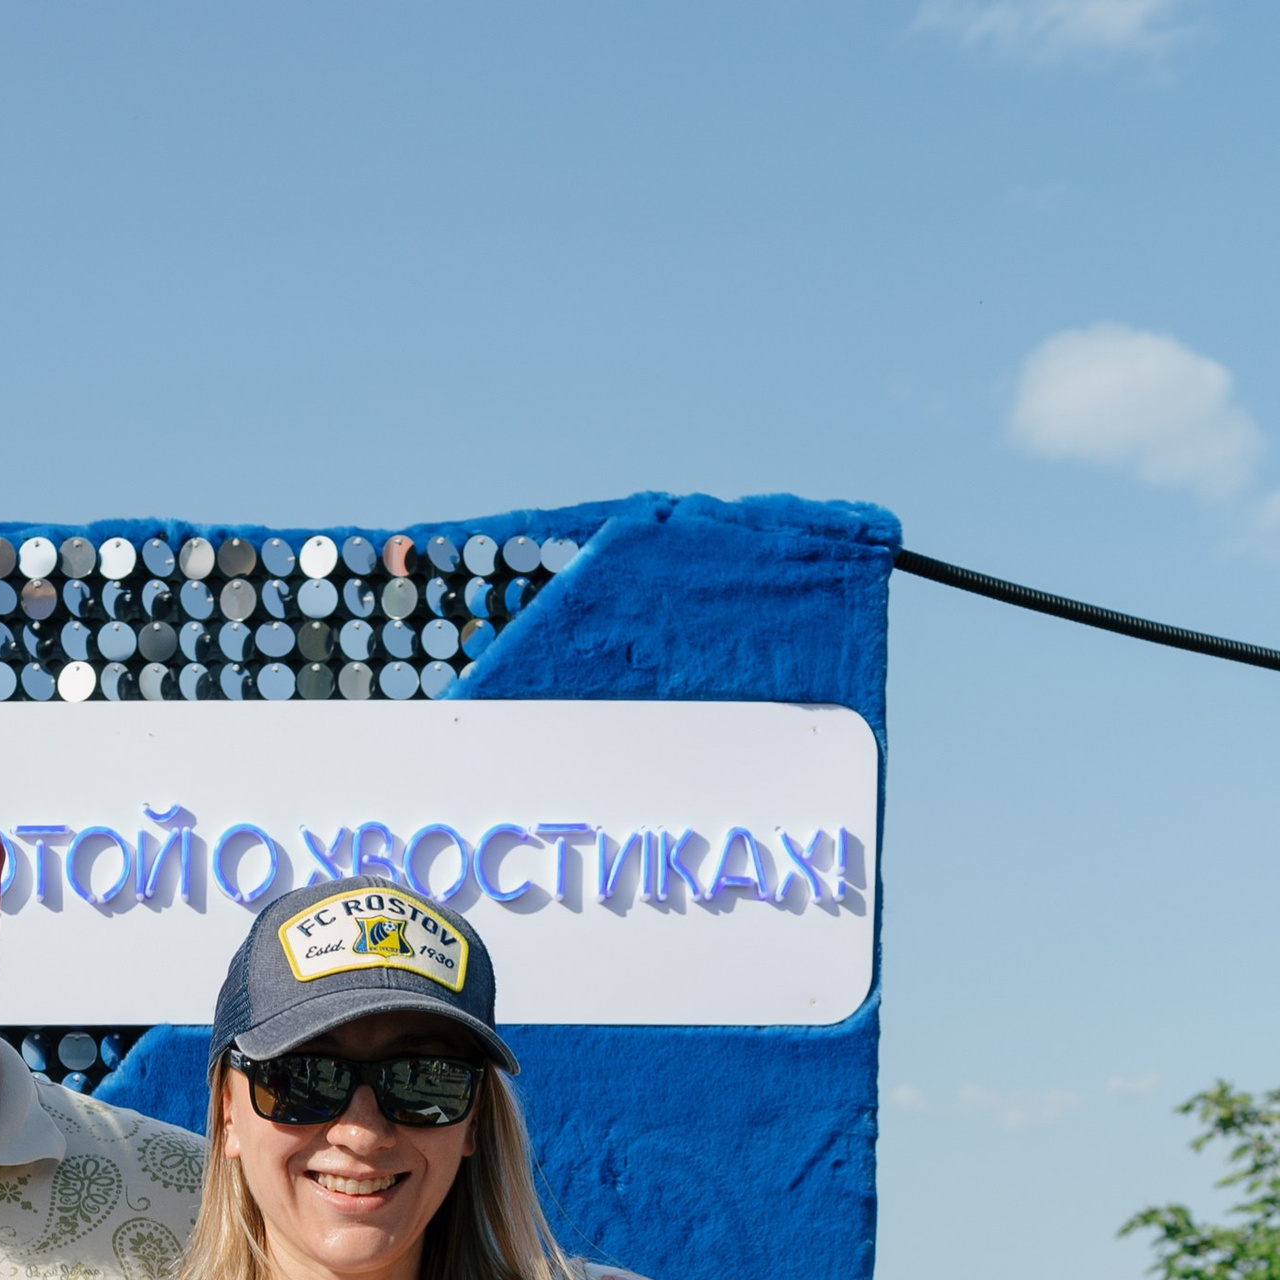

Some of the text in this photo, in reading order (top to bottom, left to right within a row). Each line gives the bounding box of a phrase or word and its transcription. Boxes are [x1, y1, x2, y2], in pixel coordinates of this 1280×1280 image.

[212, 822, 278, 904] О
[296, 894, 458, 947] FC ROSTOV
[419, 944, 455, 969] 1930
